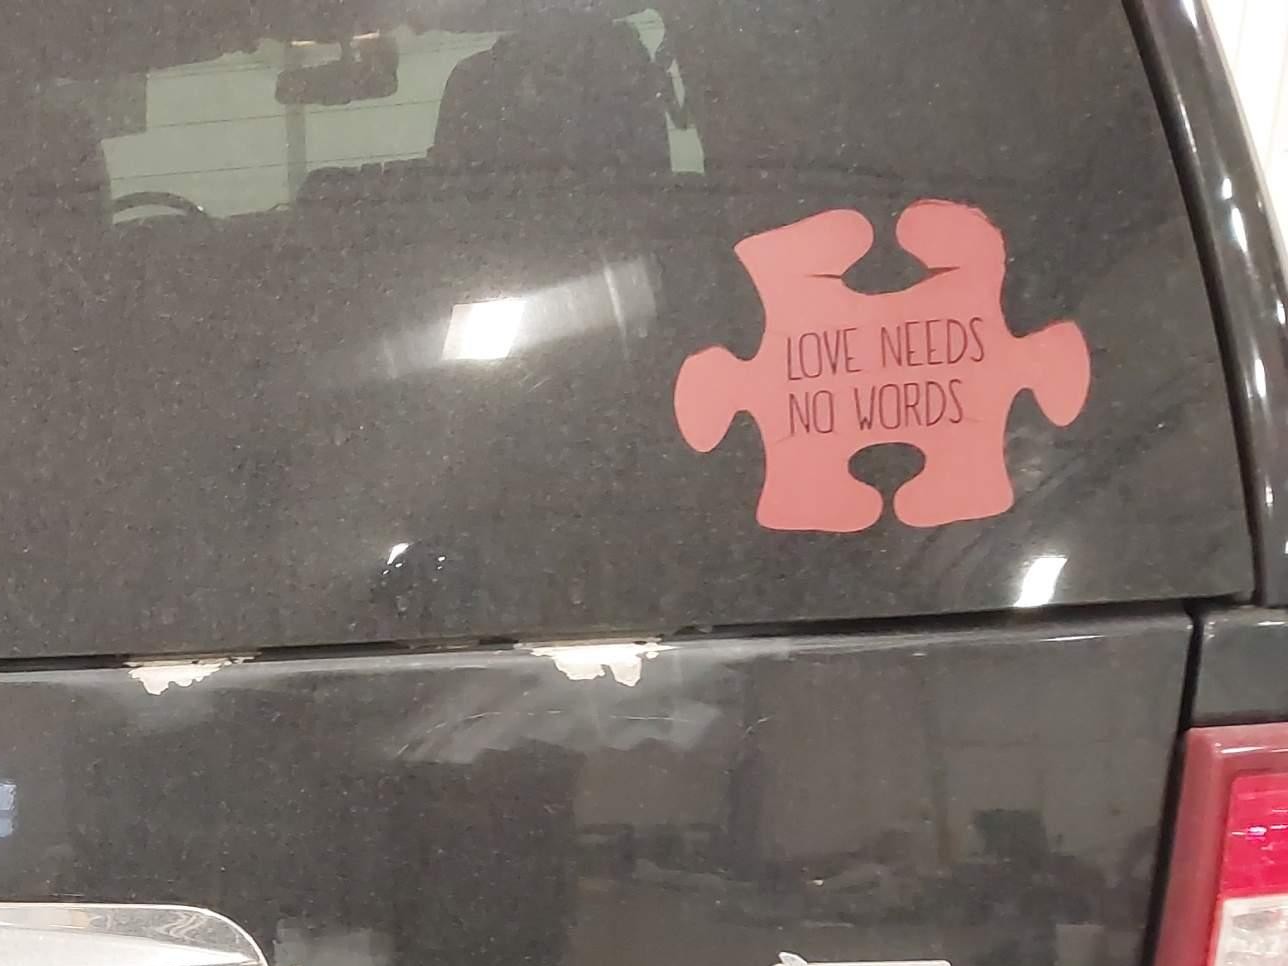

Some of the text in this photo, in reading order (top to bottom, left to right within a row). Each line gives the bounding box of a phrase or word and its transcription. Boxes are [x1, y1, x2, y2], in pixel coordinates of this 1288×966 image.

[787, 317, 985, 380] LOVE NEEDS
[789, 379, 963, 436] NO WORDS
